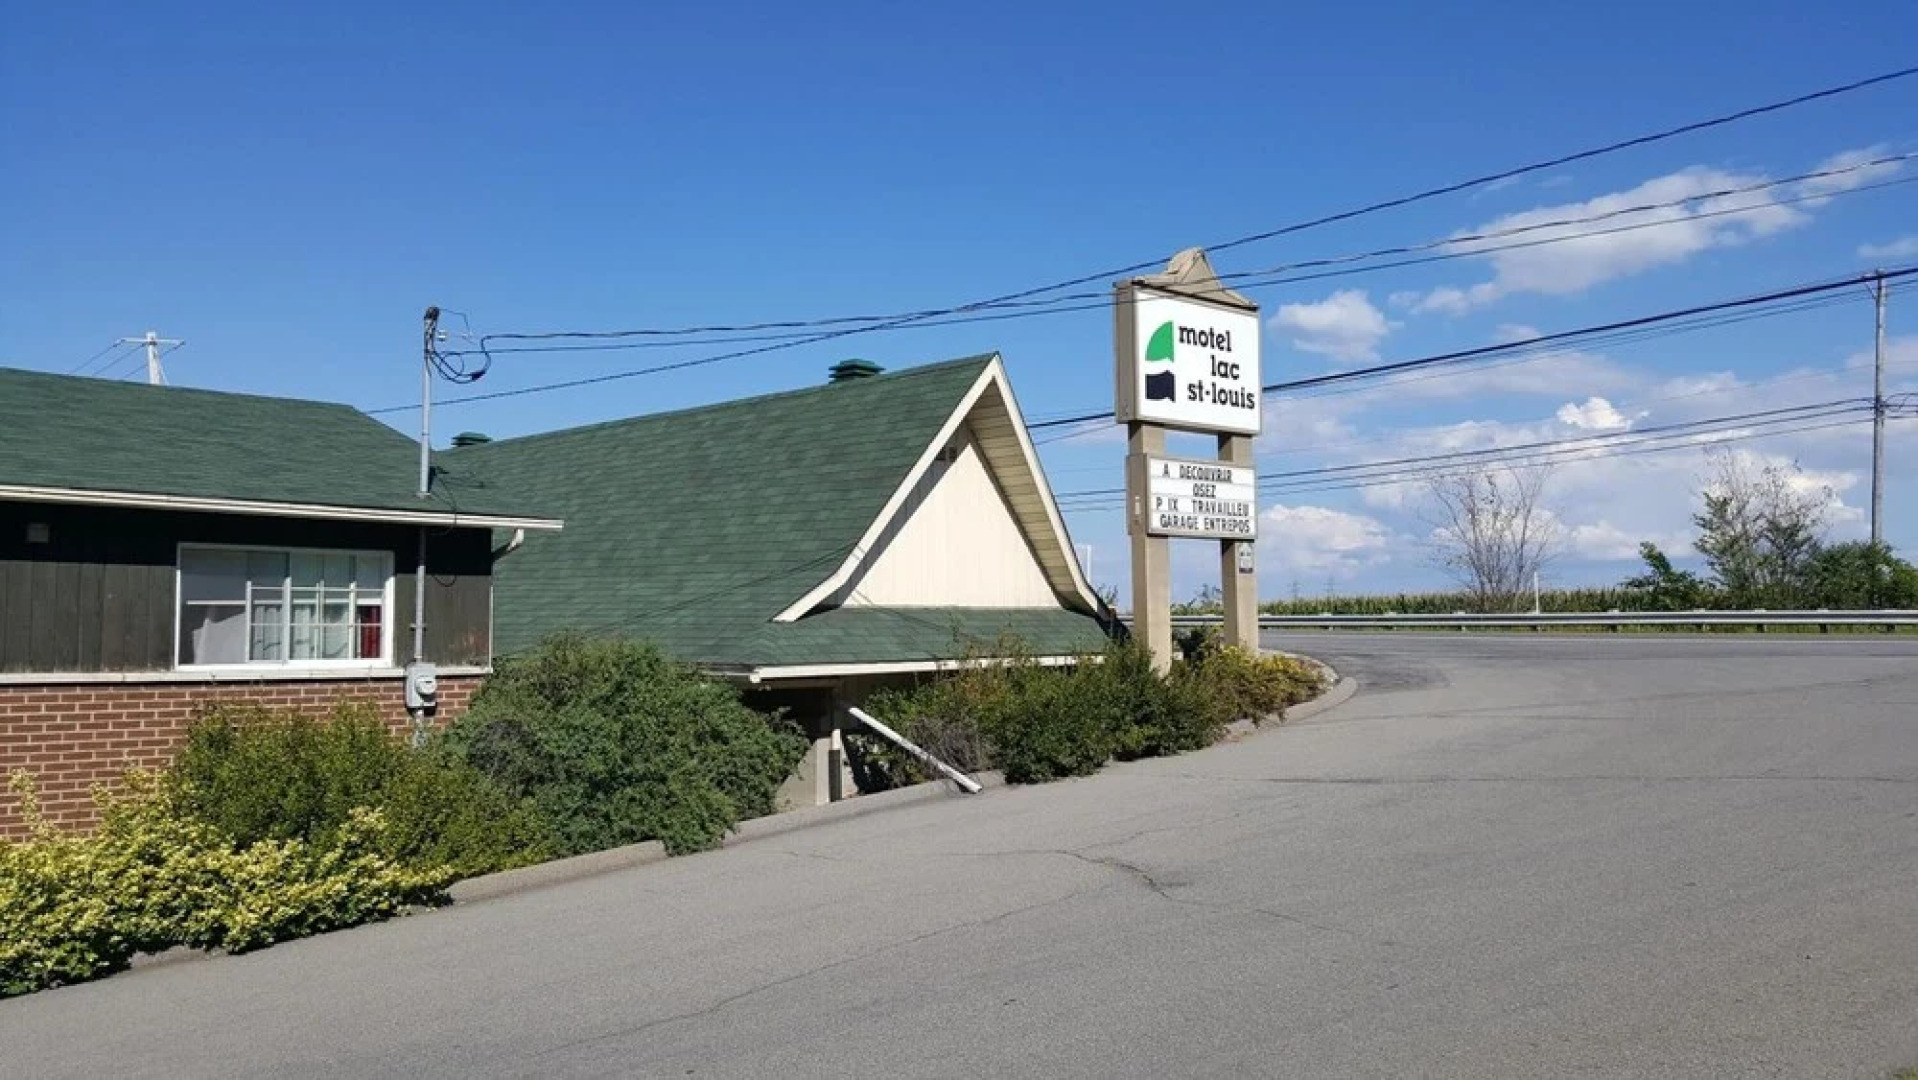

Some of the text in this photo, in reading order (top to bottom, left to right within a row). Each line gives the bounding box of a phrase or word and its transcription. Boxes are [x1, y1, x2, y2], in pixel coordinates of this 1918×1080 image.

[1178, 326, 1232, 352] motel
[1210, 354, 1240, 380] lac
[1162, 463, 1232, 483] A DECOUVRIR
[1192, 483, 1217, 499] OSEZ
[1160, 514, 1250, 534] GARAGE ENTREPOS
